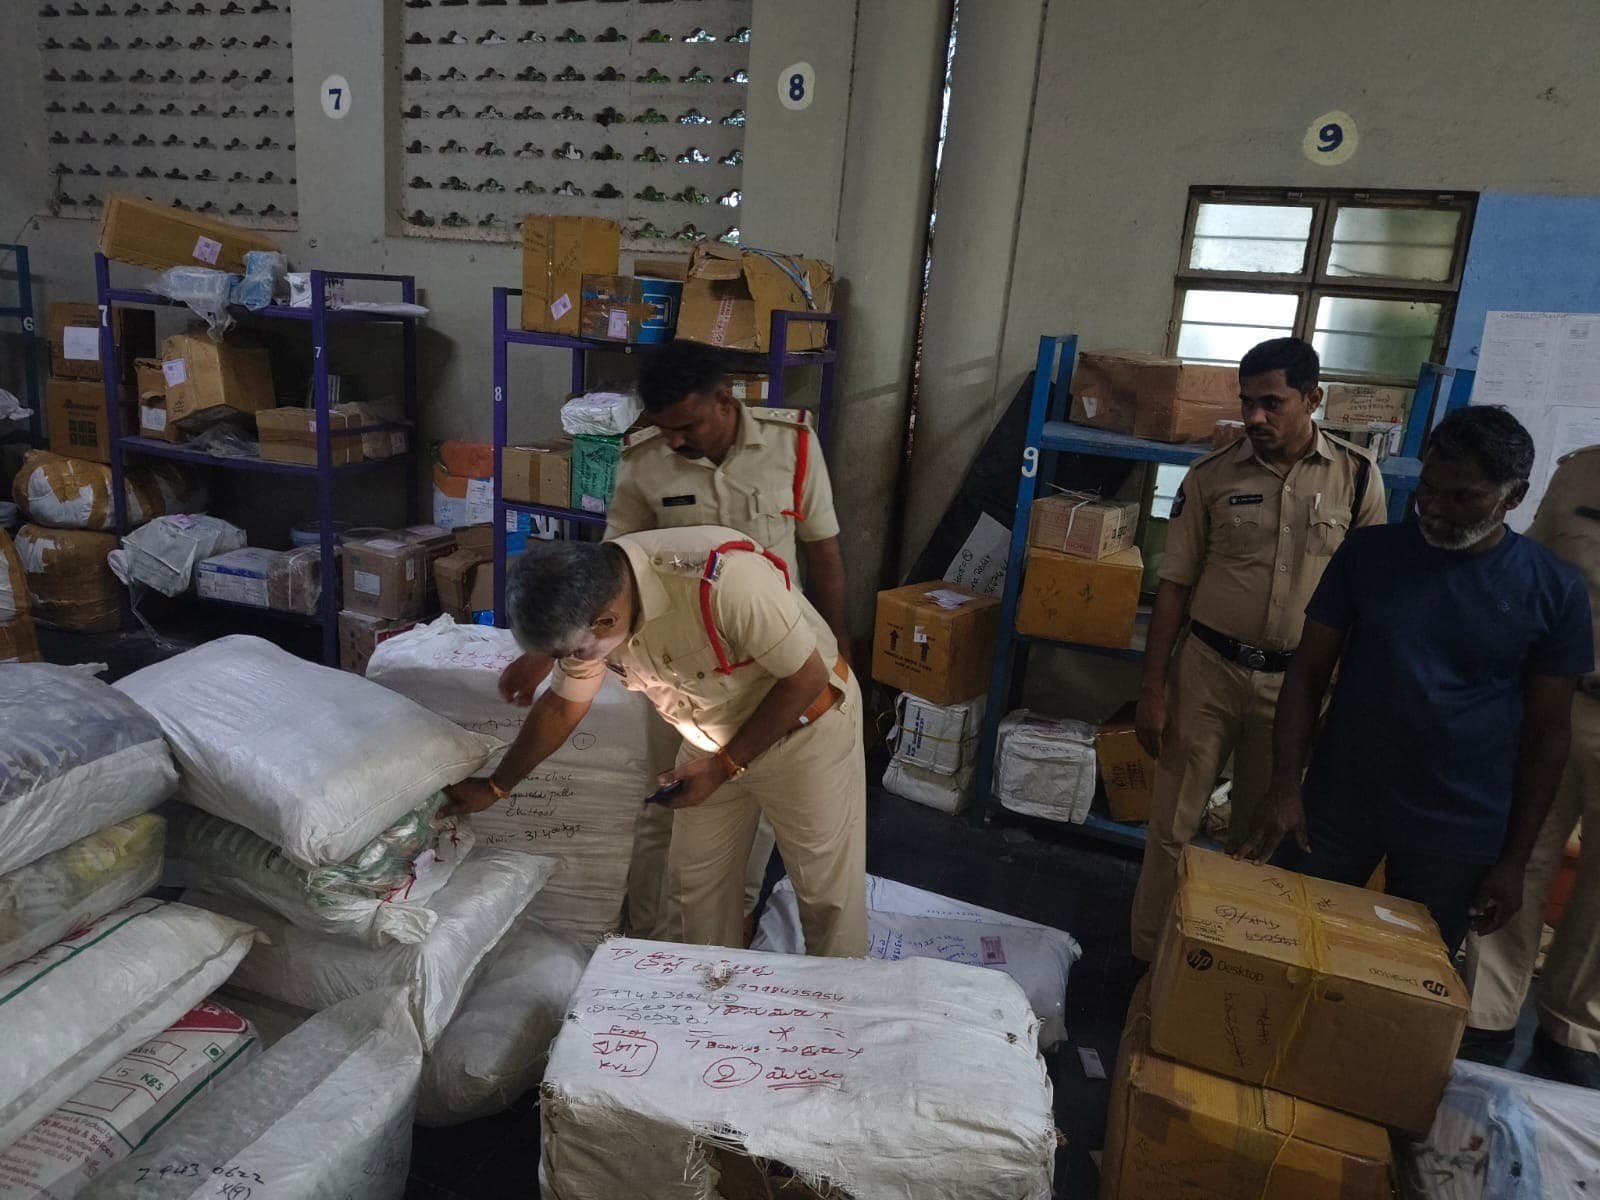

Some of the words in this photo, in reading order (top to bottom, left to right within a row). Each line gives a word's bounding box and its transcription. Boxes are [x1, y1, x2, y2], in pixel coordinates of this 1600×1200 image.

[789, 73, 804, 101] 8
[328, 88, 342, 110] 7
[1317, 123, 1343, 152] 9
[23, 317, 34, 332] 6
[98, 305, 108, 327] 7
[314, 346, 321, 359] 7
[494, 386, 502, 401] 8
[1021, 446, 1039, 478] 9
[1187, 949, 1213, 971] hp
[1217, 960, 1265, 983] Desktop
[90, 1134, 114, 1159] Spices
